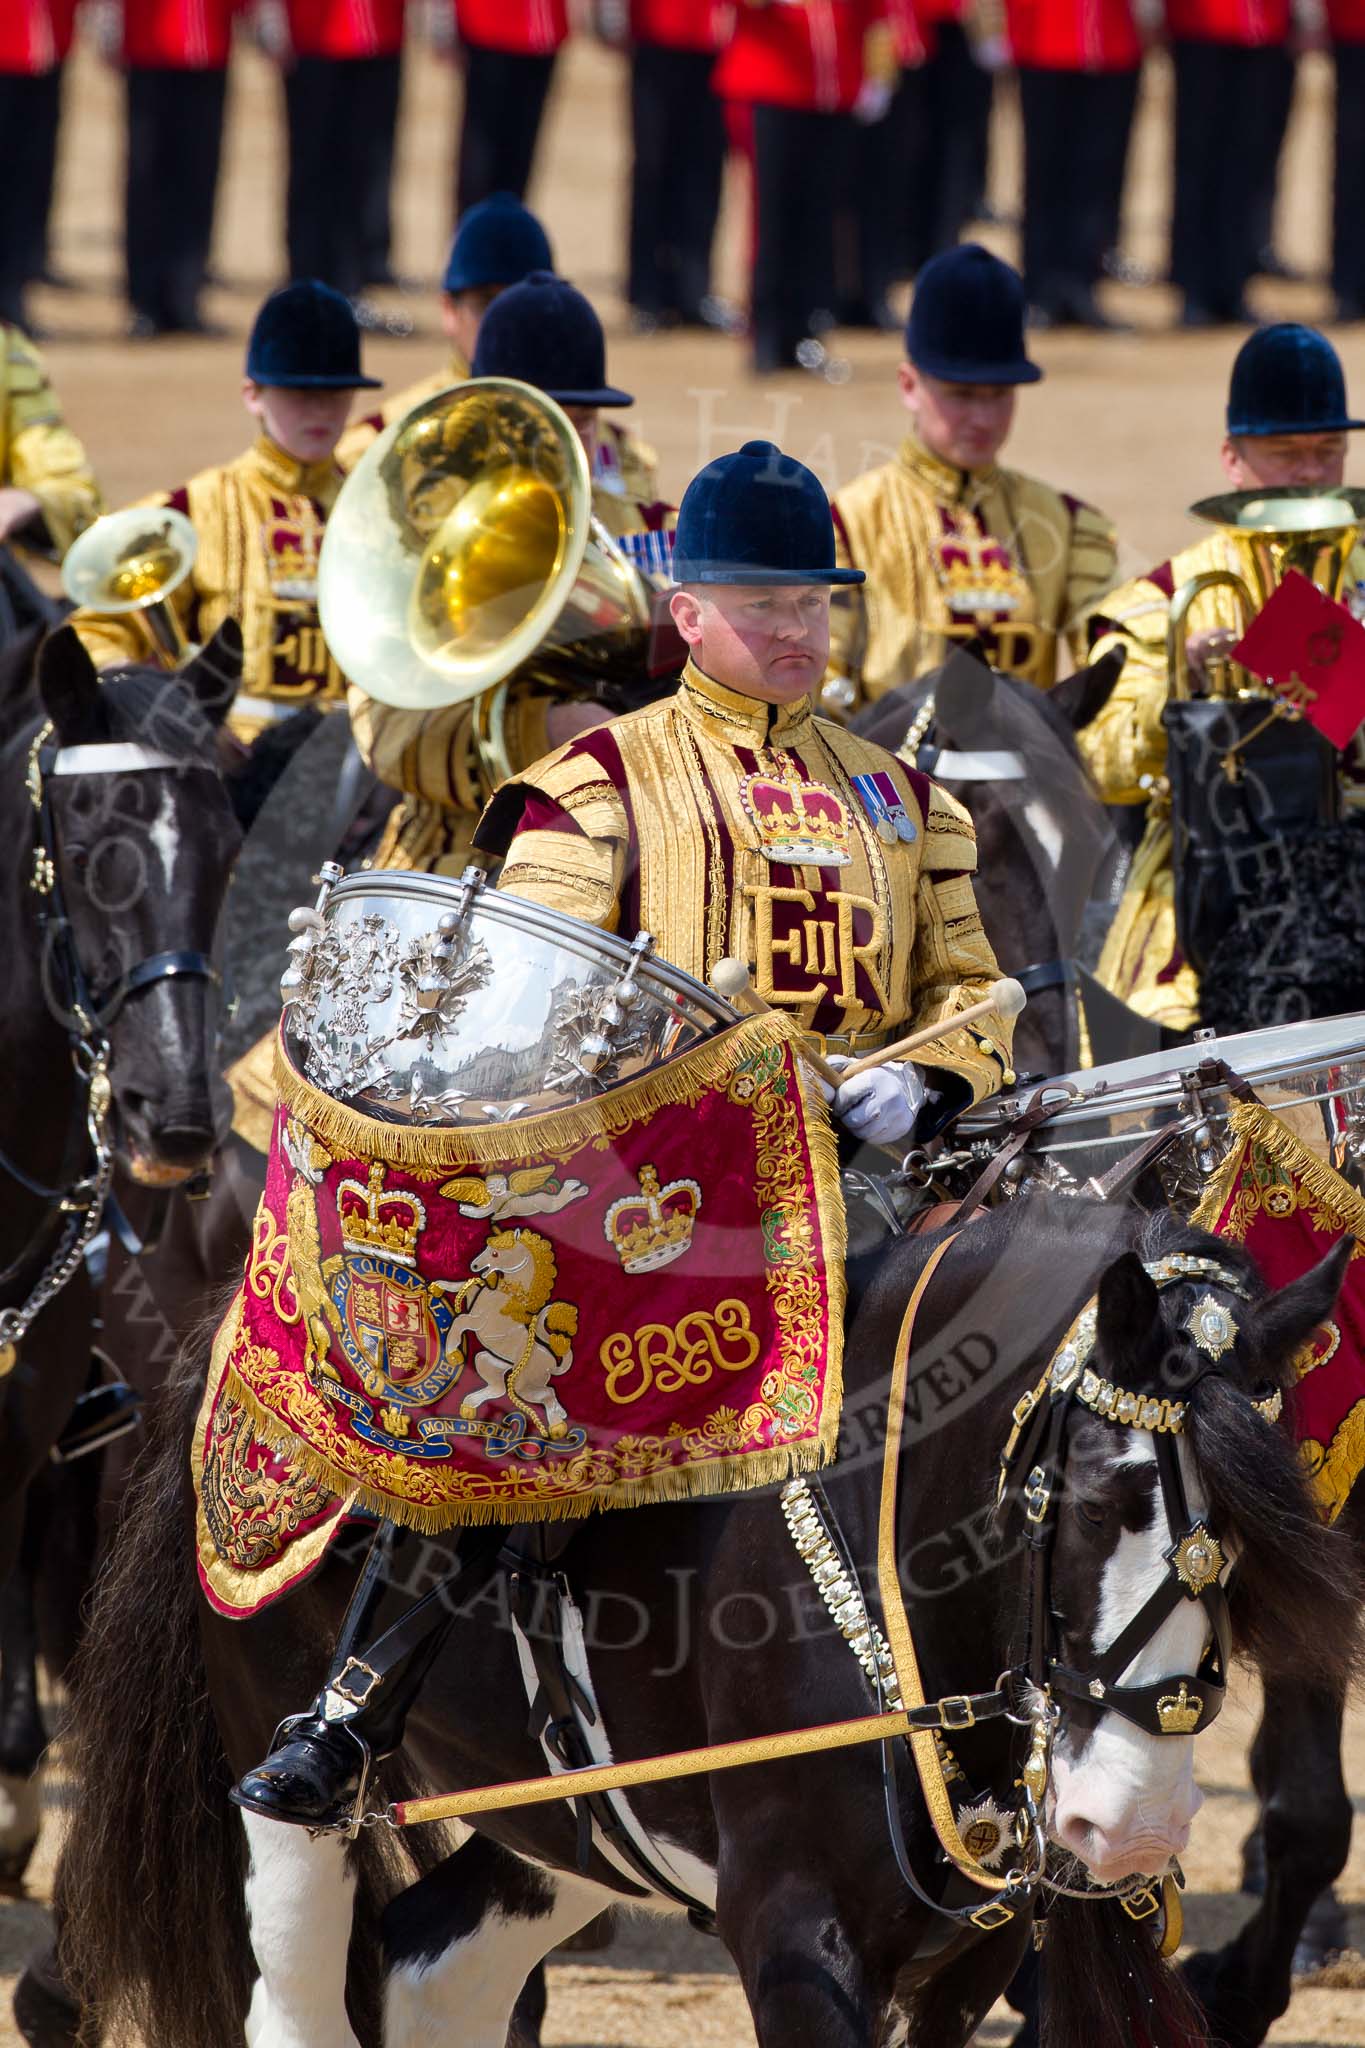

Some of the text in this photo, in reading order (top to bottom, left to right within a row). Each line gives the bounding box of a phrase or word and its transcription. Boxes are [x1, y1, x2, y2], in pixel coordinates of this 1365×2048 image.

[412, 1359, 455, 1401] ENSE
[349, 1397, 365, 1411] ET
[422, 1421, 455, 1436] MON
